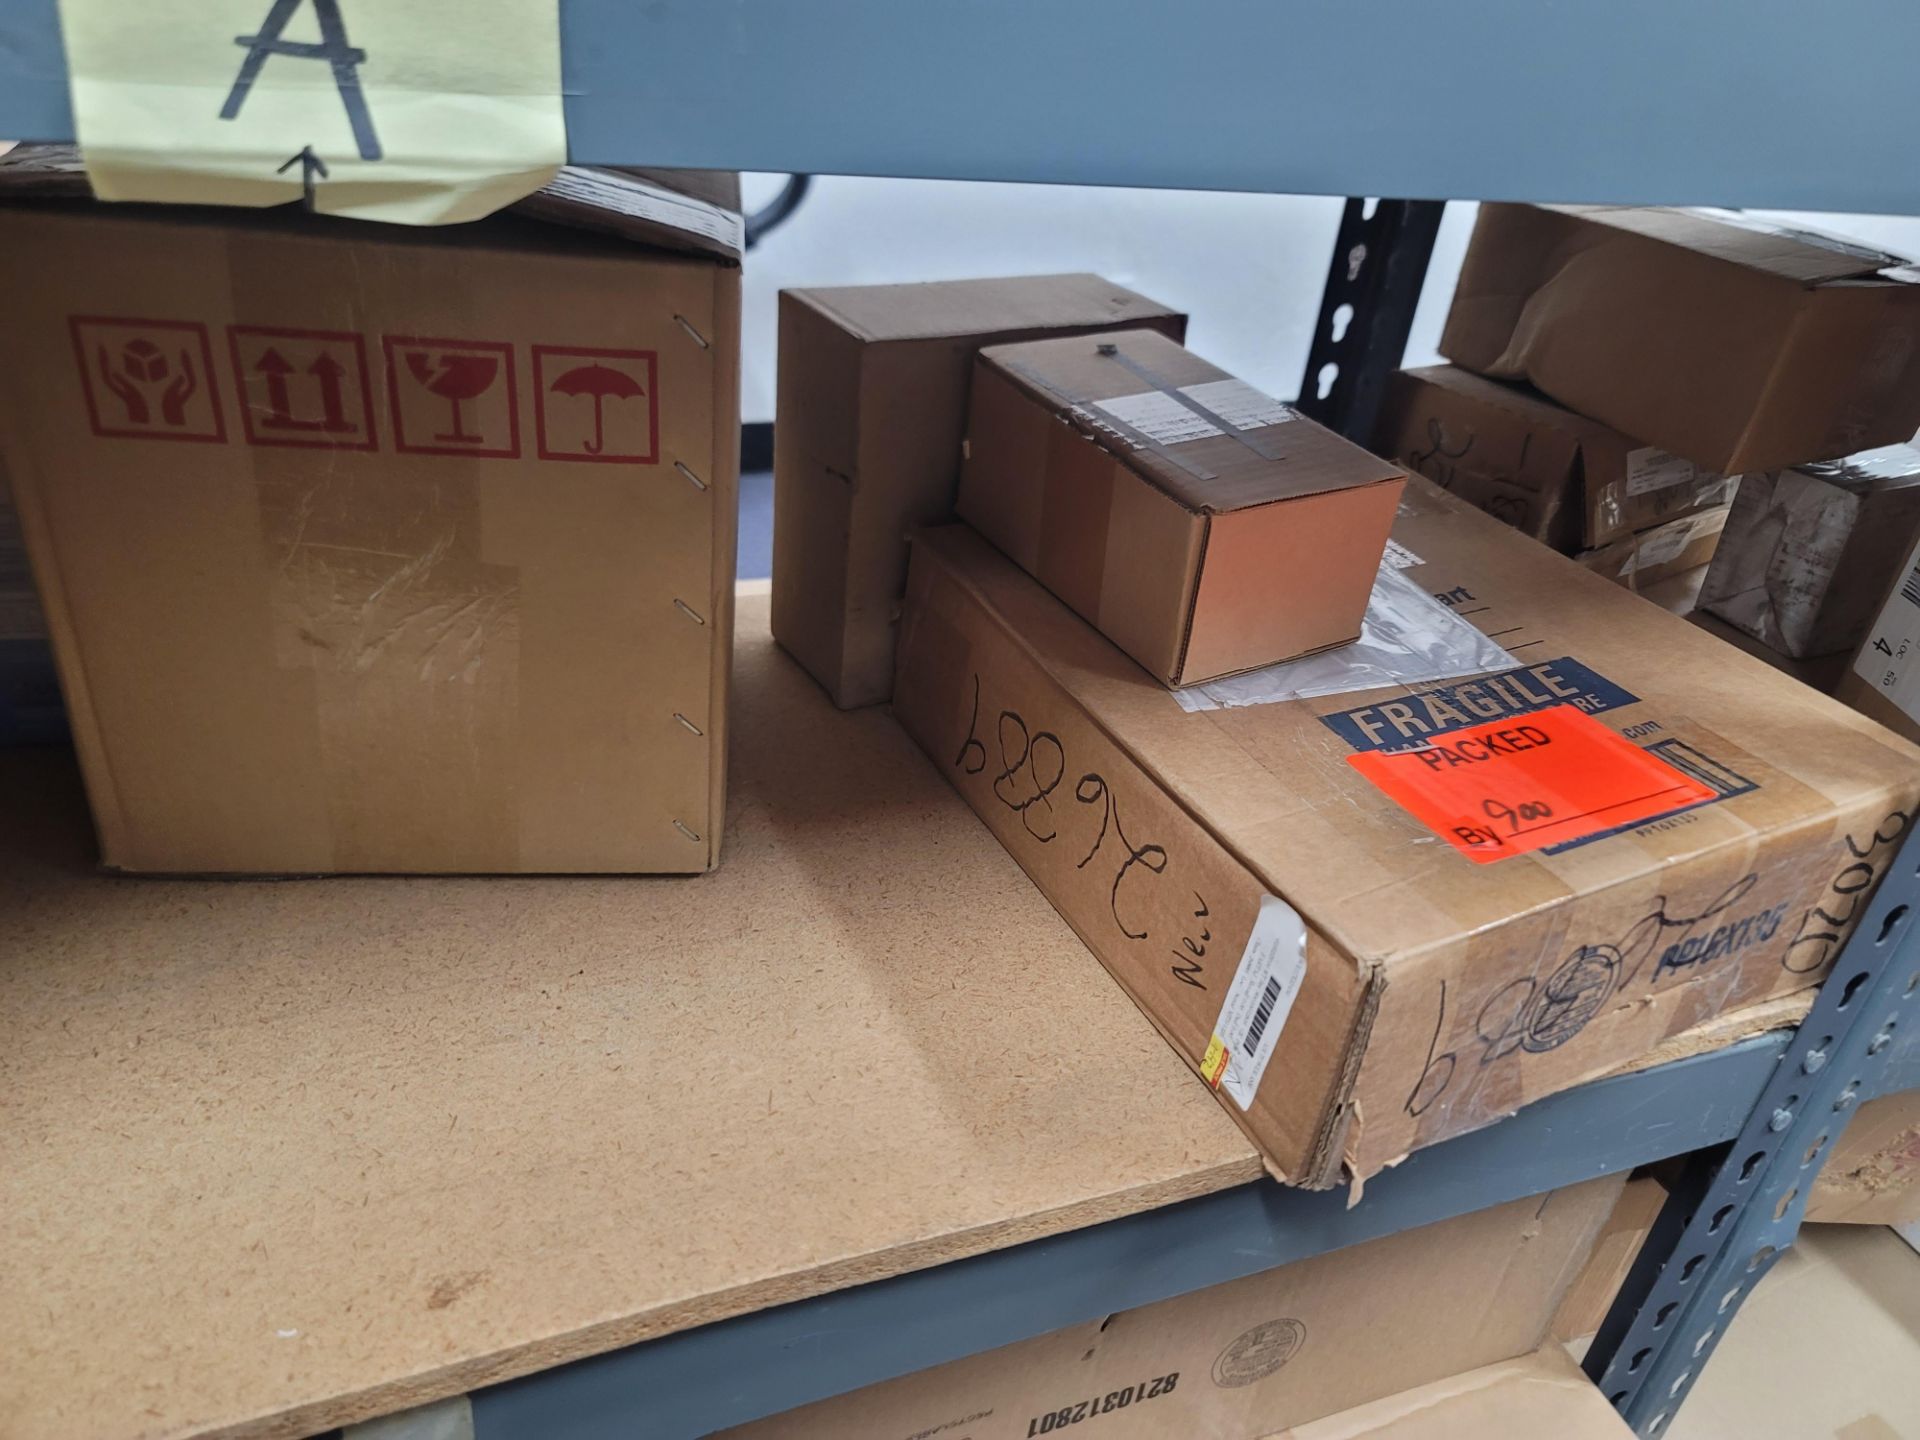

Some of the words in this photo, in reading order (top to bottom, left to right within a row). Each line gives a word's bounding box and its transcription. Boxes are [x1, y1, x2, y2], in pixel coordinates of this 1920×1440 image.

[220, 0, 383, 161] A
[1438, 585, 1476, 607] art
[1872, 637, 1892, 656] 4
[1348, 665, 1581, 747] FRAGILE
[1418, 725, 1552, 772] PACKED
[1452, 823, 1503, 847] By
[1026, 1370, 1181, 1439] 8210312801
